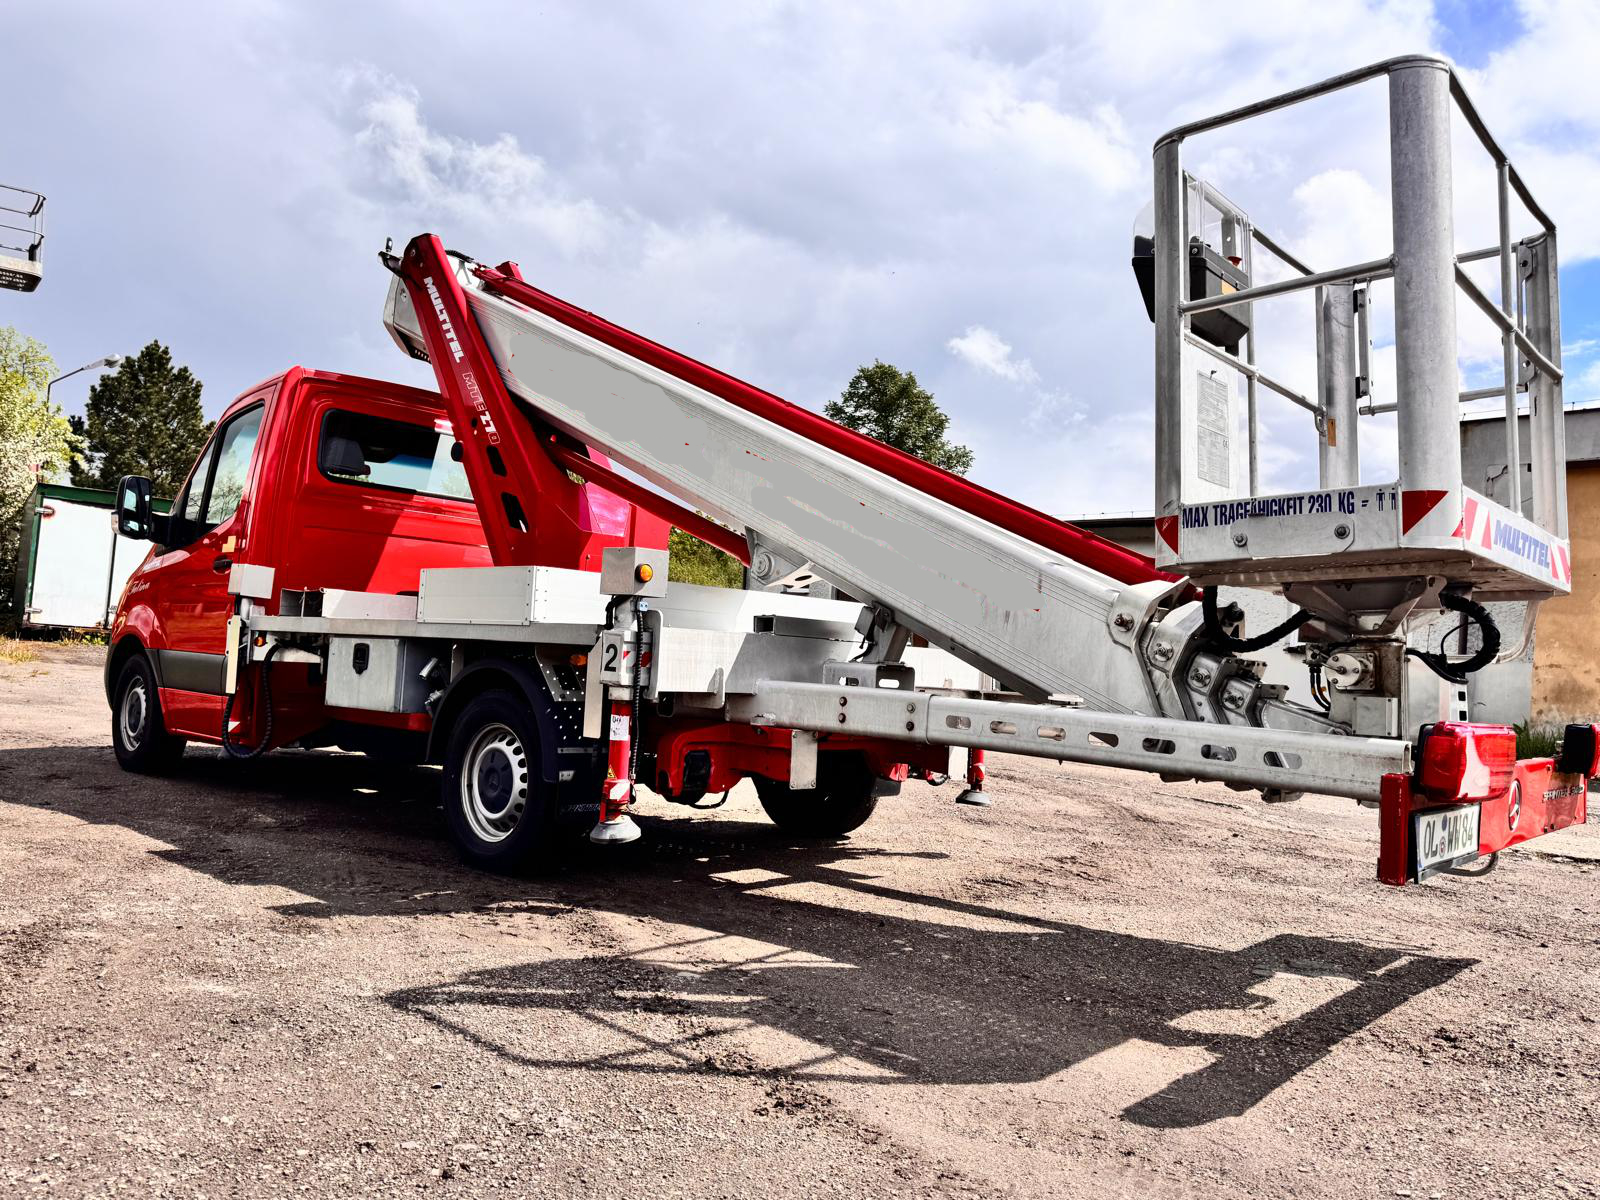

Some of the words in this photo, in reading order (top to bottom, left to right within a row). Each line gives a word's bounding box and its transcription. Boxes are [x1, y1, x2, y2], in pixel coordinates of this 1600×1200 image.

[424, 277, 465, 363] MULTITEL
[1182, 505, 1209, 529] MAX
[1308, 493, 1332, 513] 230
[1338, 491, 1355, 514] KG
[1494, 519, 1550, 569] MULTITEL
[603, 643, 618, 672] 2
[1423, 820, 1438, 860] OL
